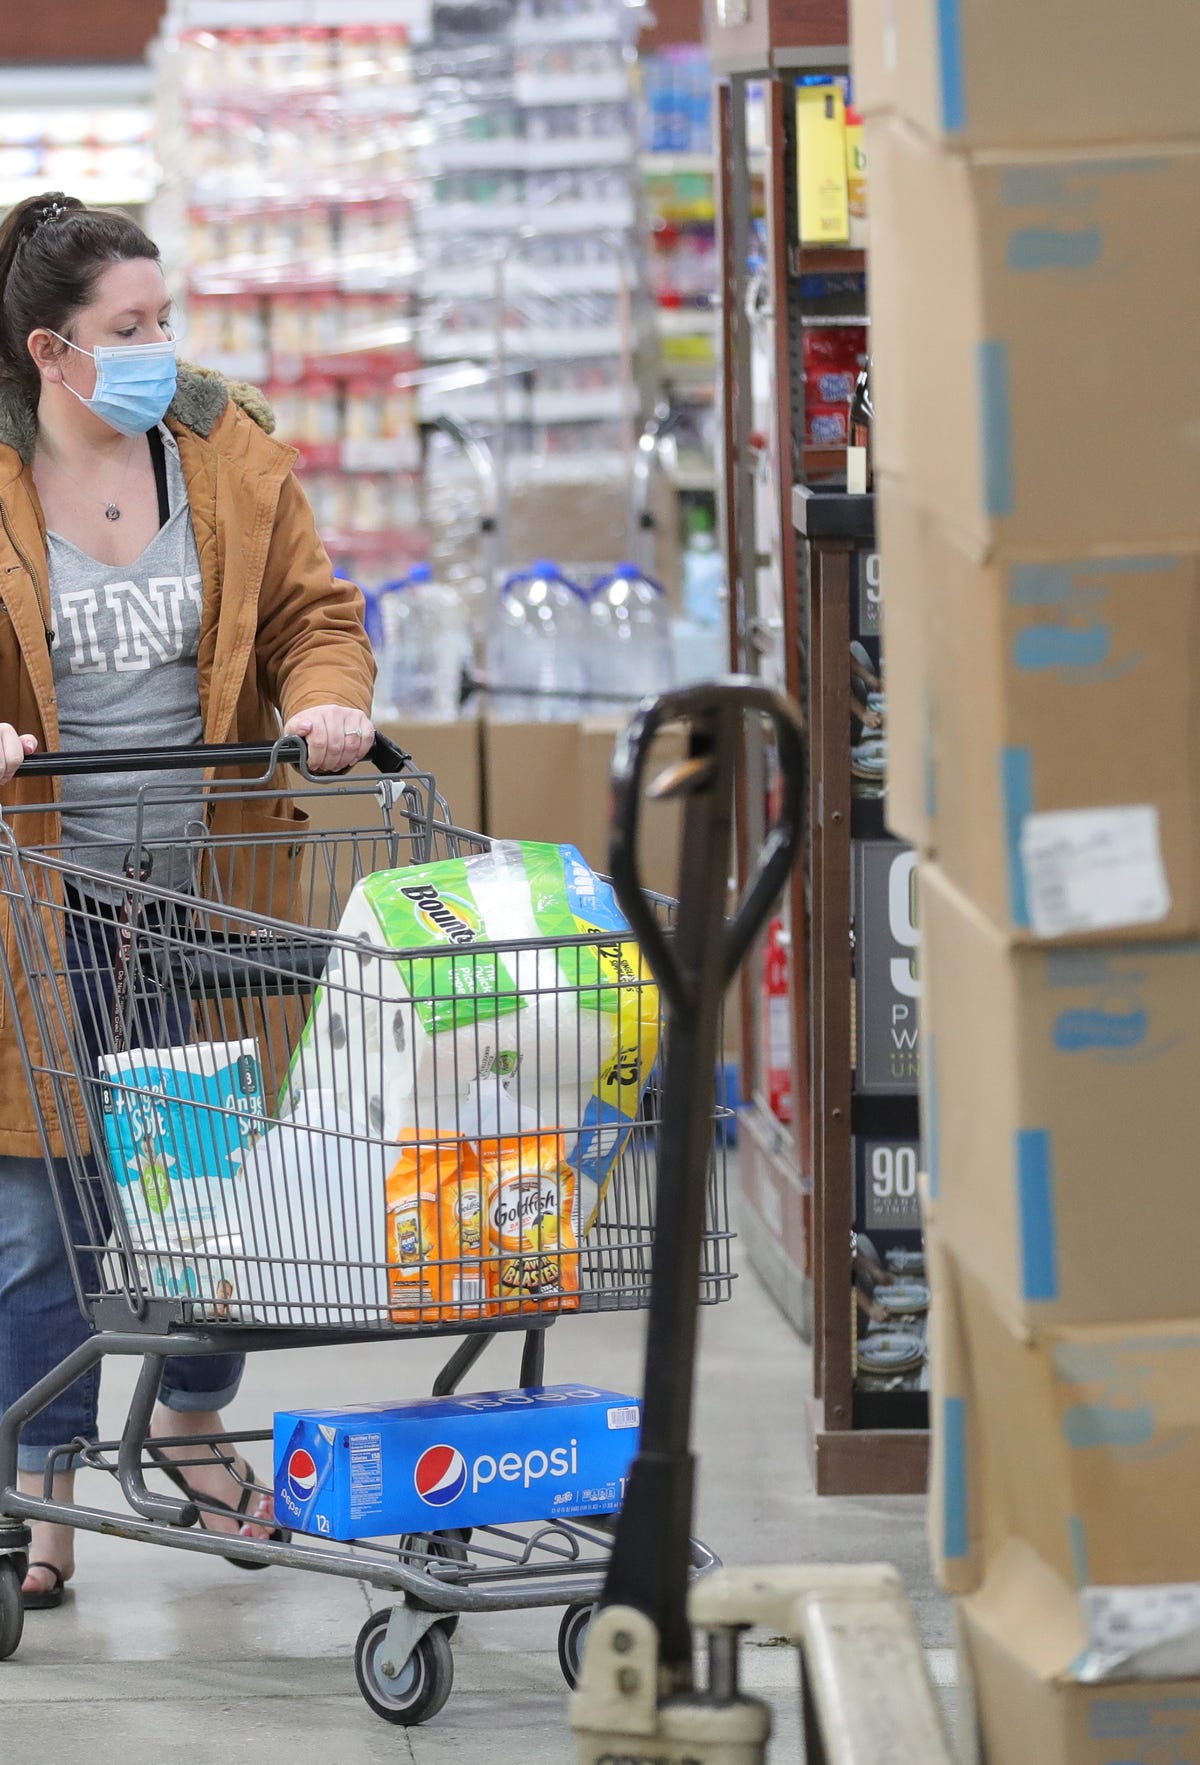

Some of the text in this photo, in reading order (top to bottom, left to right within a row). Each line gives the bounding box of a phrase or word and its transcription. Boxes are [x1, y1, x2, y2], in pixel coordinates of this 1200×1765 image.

[872, 1147, 915, 1197] 90
[495, 1190, 555, 1228] Goldfish
[472, 1438, 578, 1493] pepsi
[280, 1488, 302, 1517] pepsi
